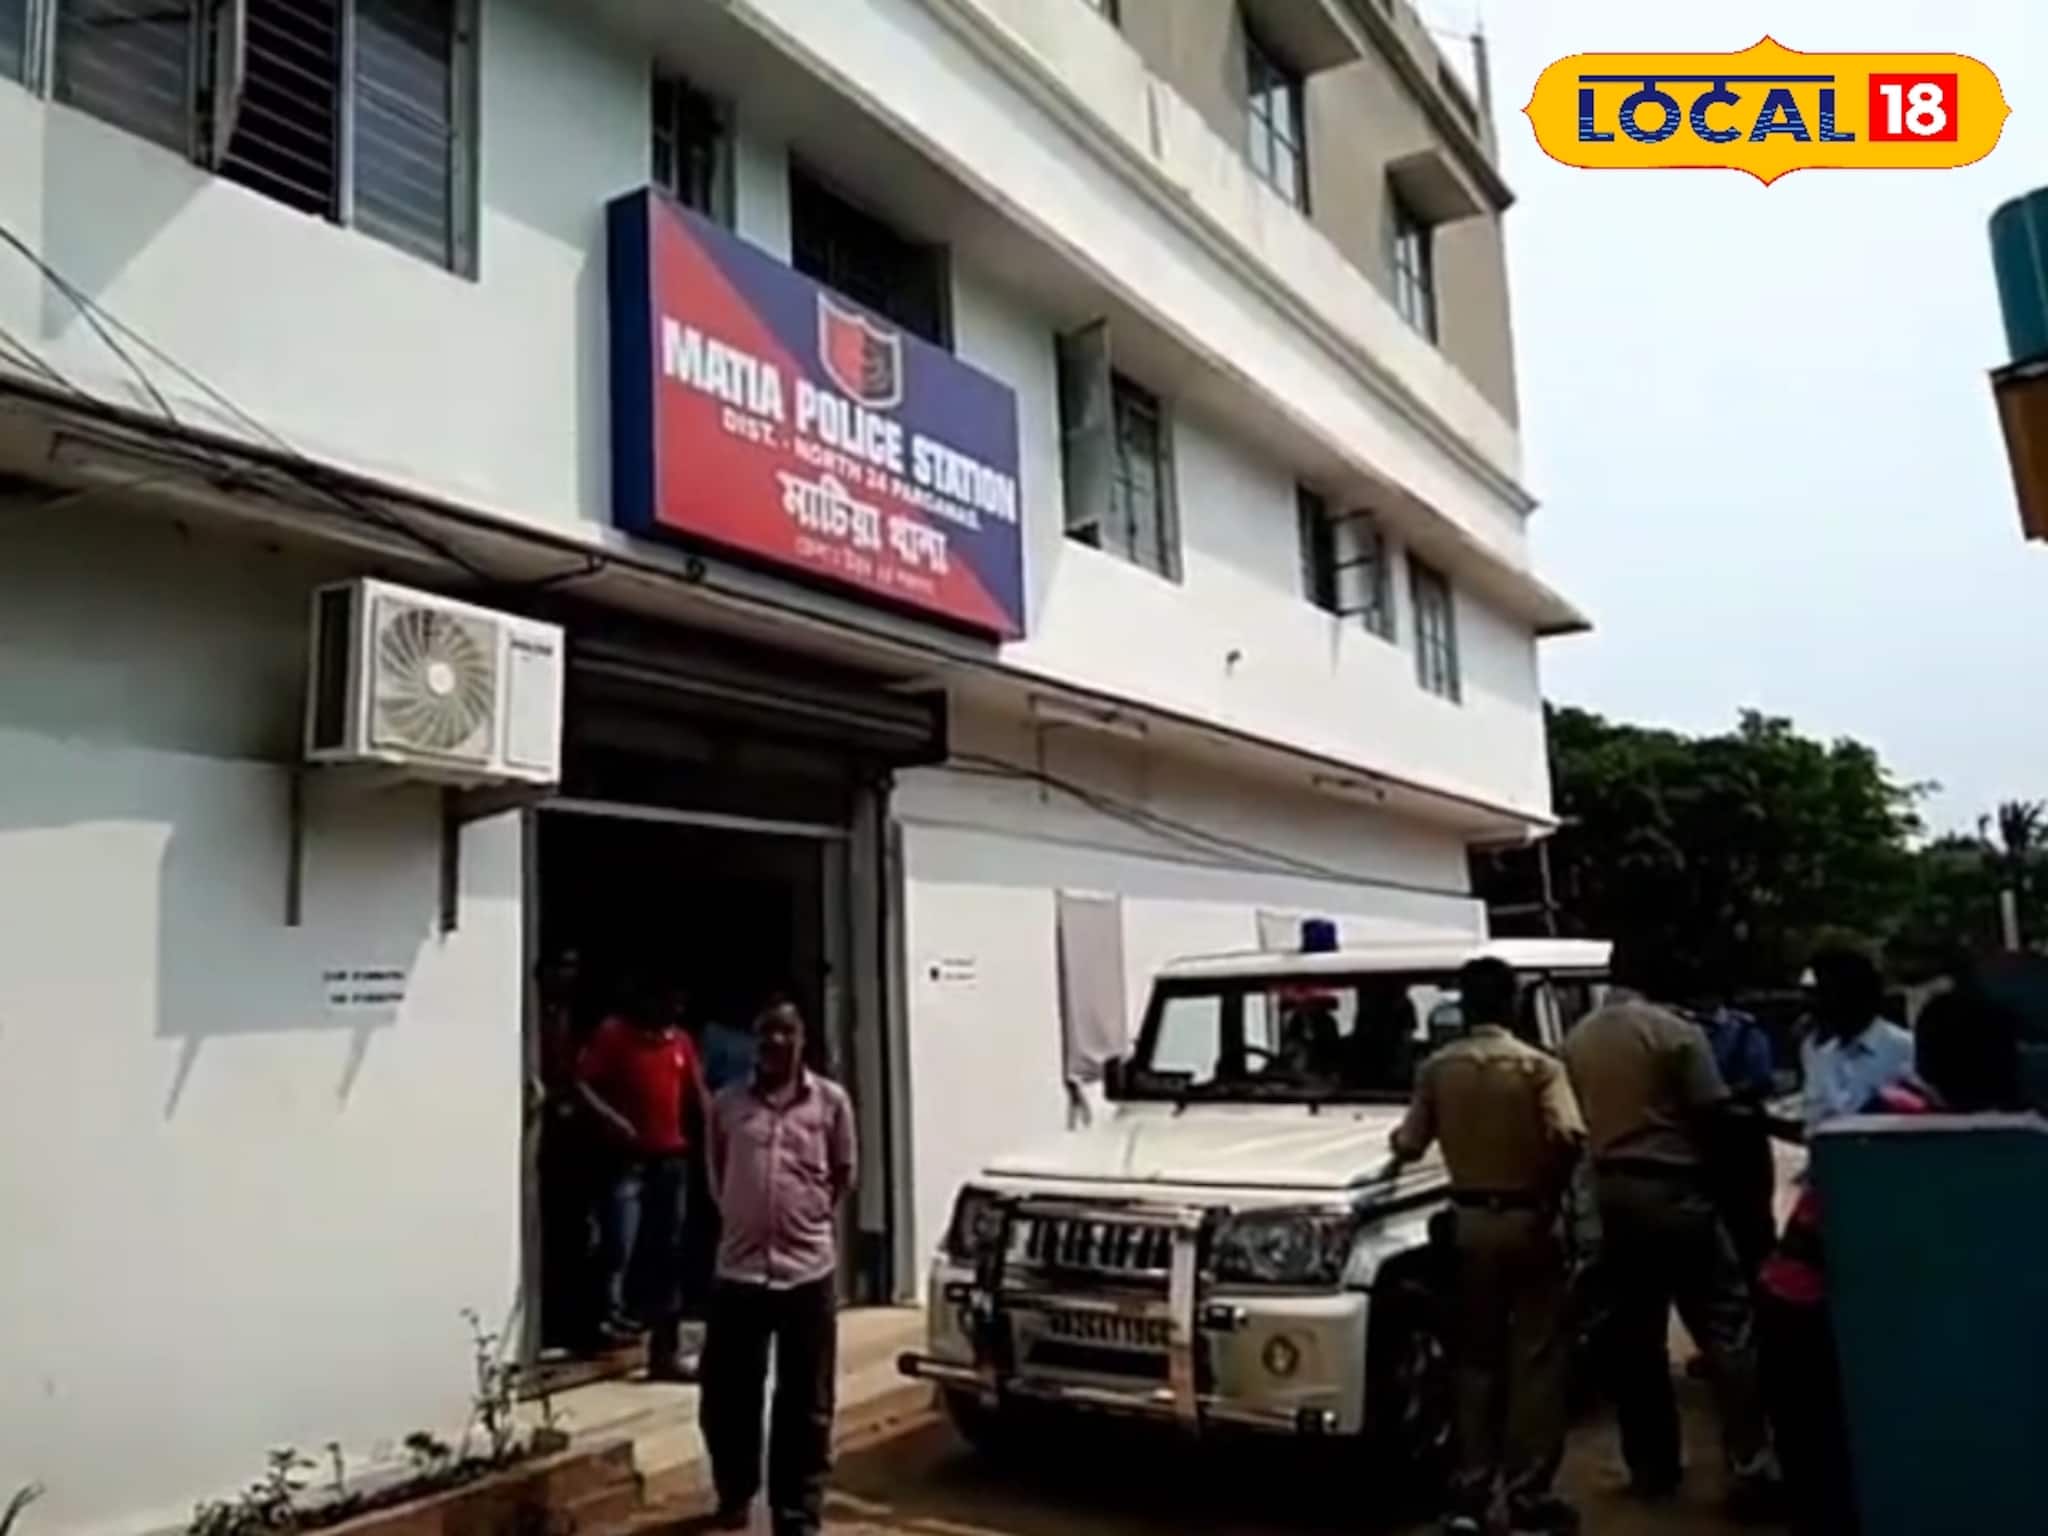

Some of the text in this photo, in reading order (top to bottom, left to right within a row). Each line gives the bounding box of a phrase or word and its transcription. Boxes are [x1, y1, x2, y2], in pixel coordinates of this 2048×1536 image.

[662, 317, 1017, 523] MATIA POLICE STATION
